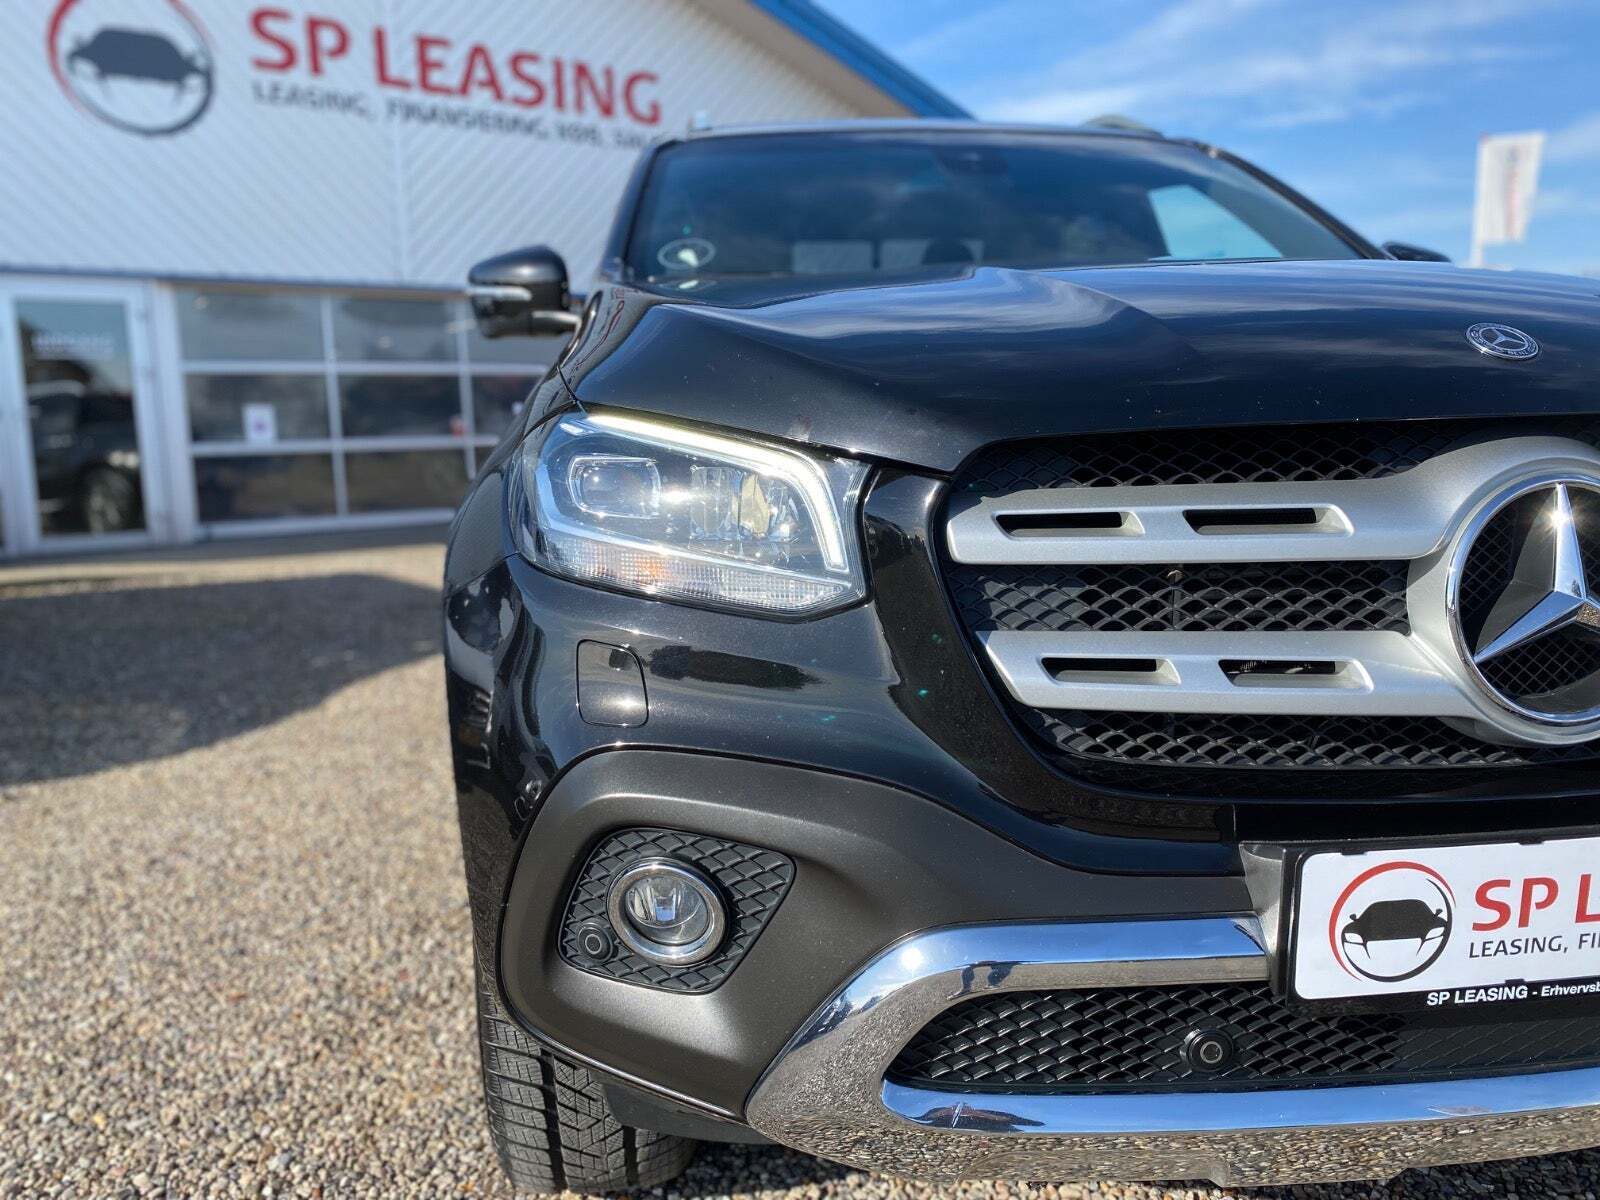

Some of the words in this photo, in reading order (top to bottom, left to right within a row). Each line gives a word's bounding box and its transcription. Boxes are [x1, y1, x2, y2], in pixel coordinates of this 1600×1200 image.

[249, 7, 350, 77] SP
[373, 25, 661, 126] LEASING
[1472, 877, 1559, 931] SP
[1469, 935, 1568, 958] LEASING,
[1578, 932, 1600, 950] FI
[1426, 991, 1450, 1006] SP
[1454, 985, 1529, 1004] LEASING
